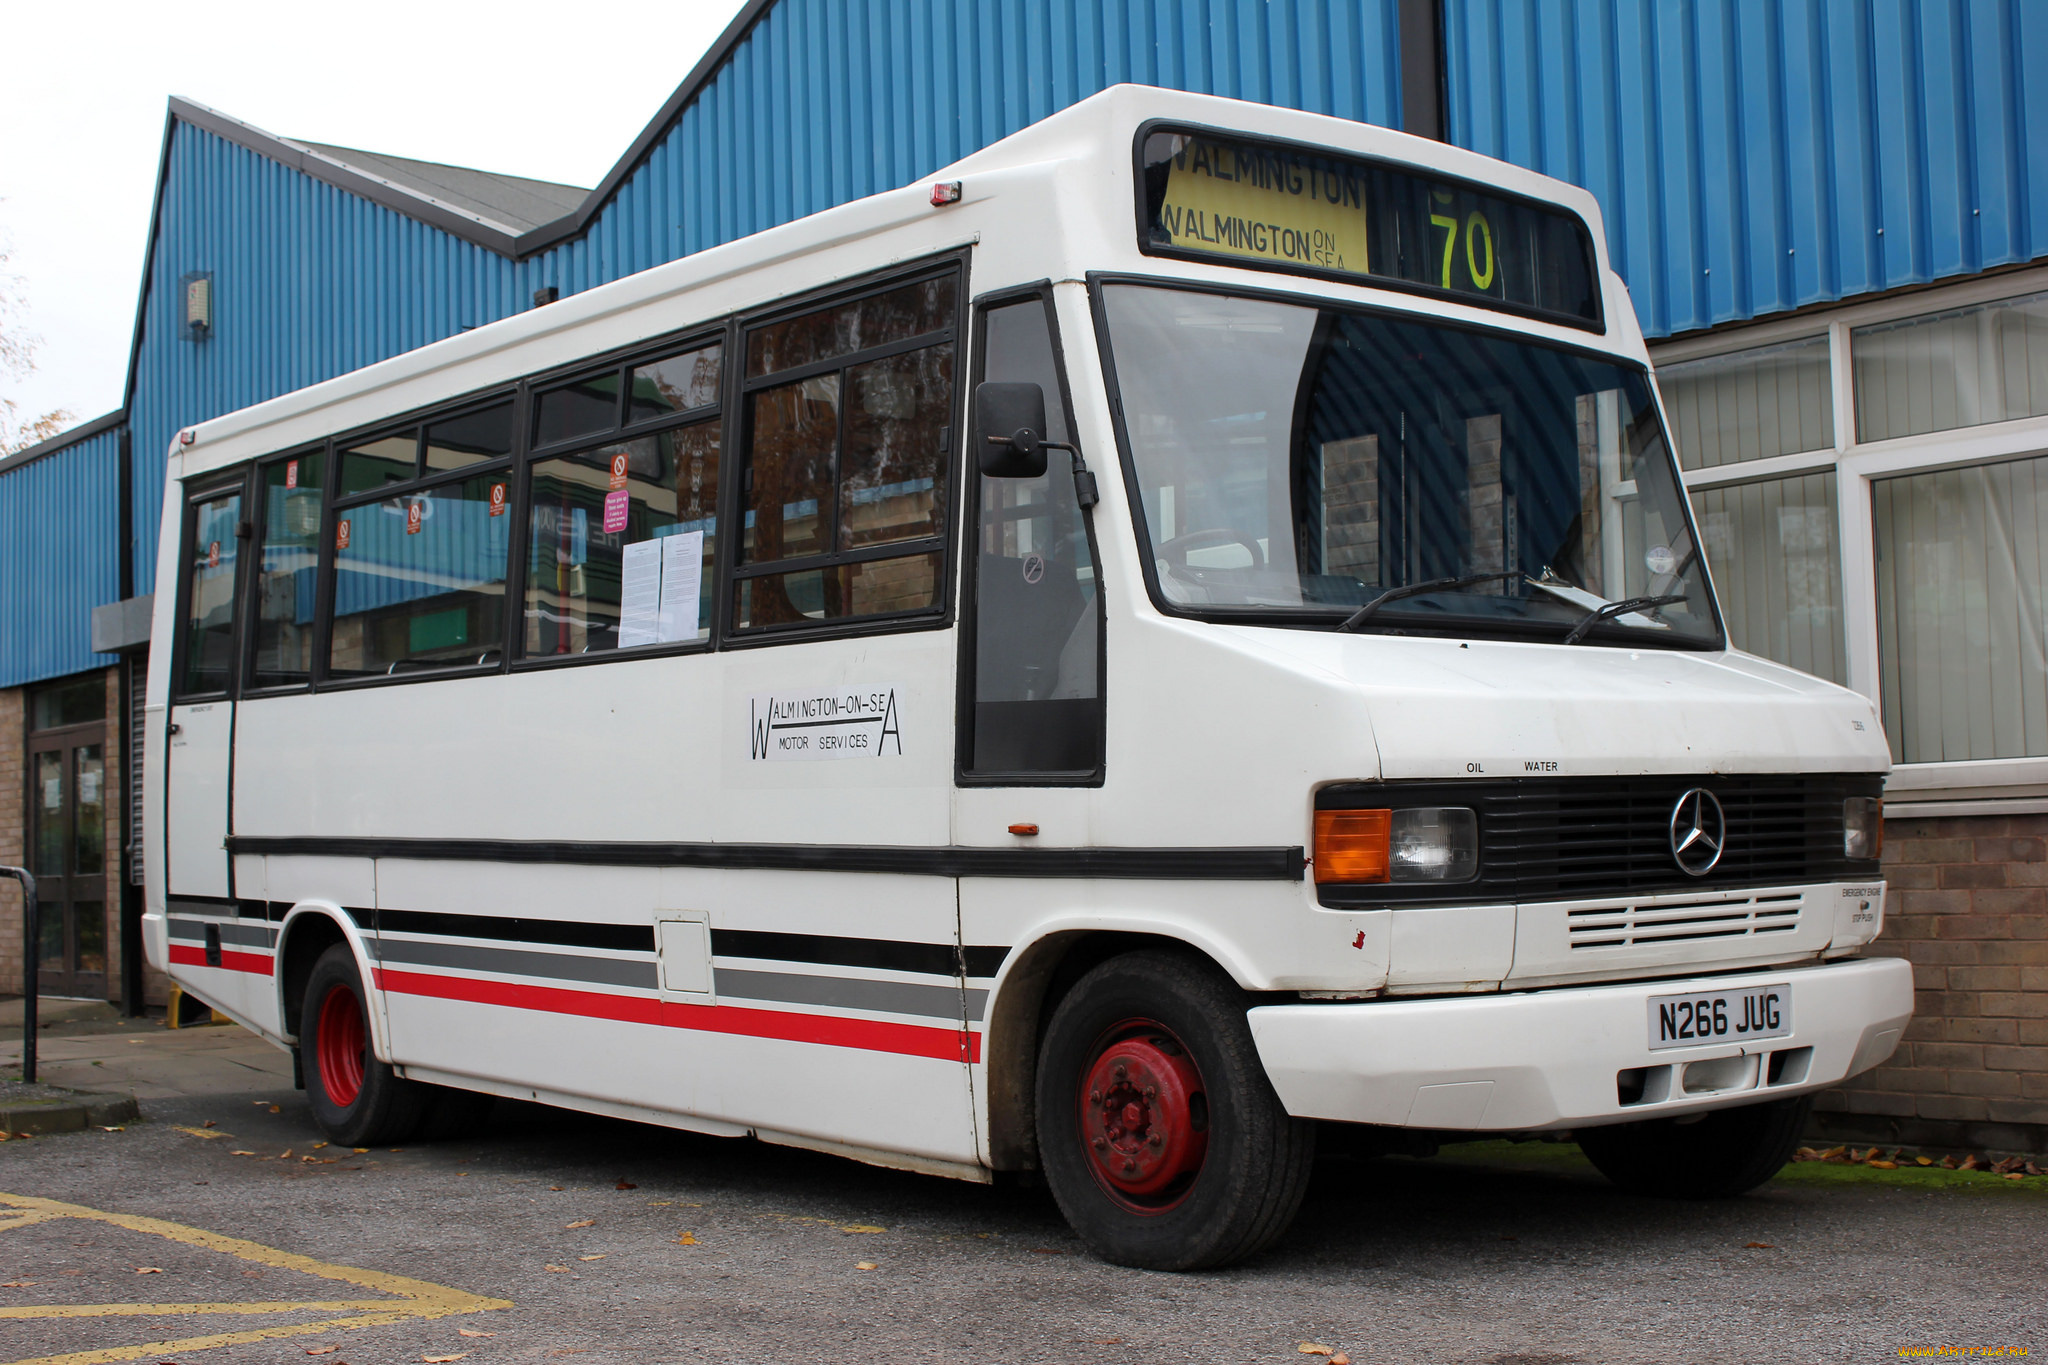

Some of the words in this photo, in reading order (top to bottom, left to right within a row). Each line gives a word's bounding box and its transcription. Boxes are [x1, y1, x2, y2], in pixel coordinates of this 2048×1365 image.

[1314, 229, 1335, 252] ON
[1430, 211, 1493, 290] 70
[1315, 250, 1345, 270] SEA
[752, 688, 902, 760] WALMINGTON-ON-SEA
[779, 736, 809, 750] MOTOR
[819, 734, 868, 750] SERVICES
[1466, 762, 1484, 773] OIL
[1524, 761, 1558, 772] WATER
[1660, 998, 1728, 1041] N266
[1736, 994, 1780, 1033] JUG
